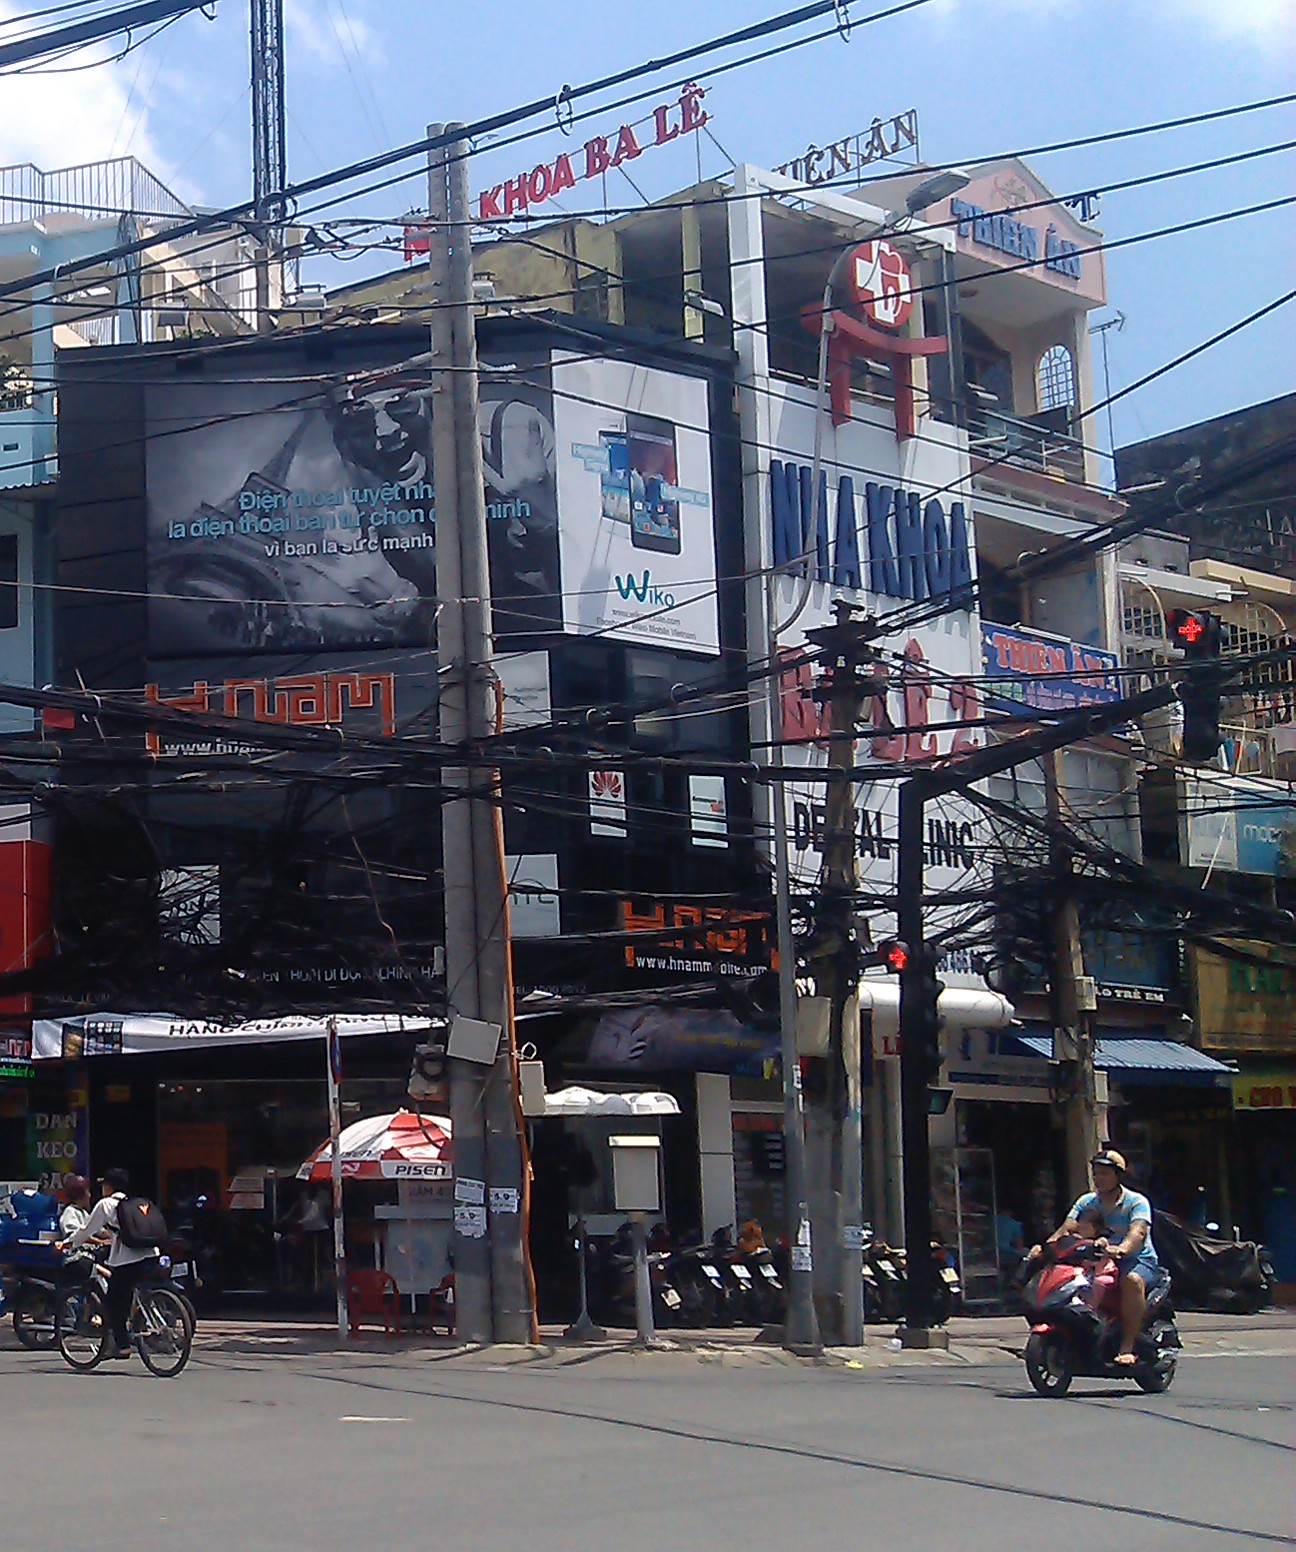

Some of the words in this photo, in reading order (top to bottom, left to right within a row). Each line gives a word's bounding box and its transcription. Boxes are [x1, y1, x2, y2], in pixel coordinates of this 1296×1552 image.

[479, 153, 577, 220] KHOA
[584, 124, 642, 178] BA
[653, 82, 710, 146] LÊ
[239, 488, 288, 513] Điện
[383, 531, 434, 554] mạnh
[867, 481, 971, 600] KHOA
[36, 1141, 78, 1158] KEO
